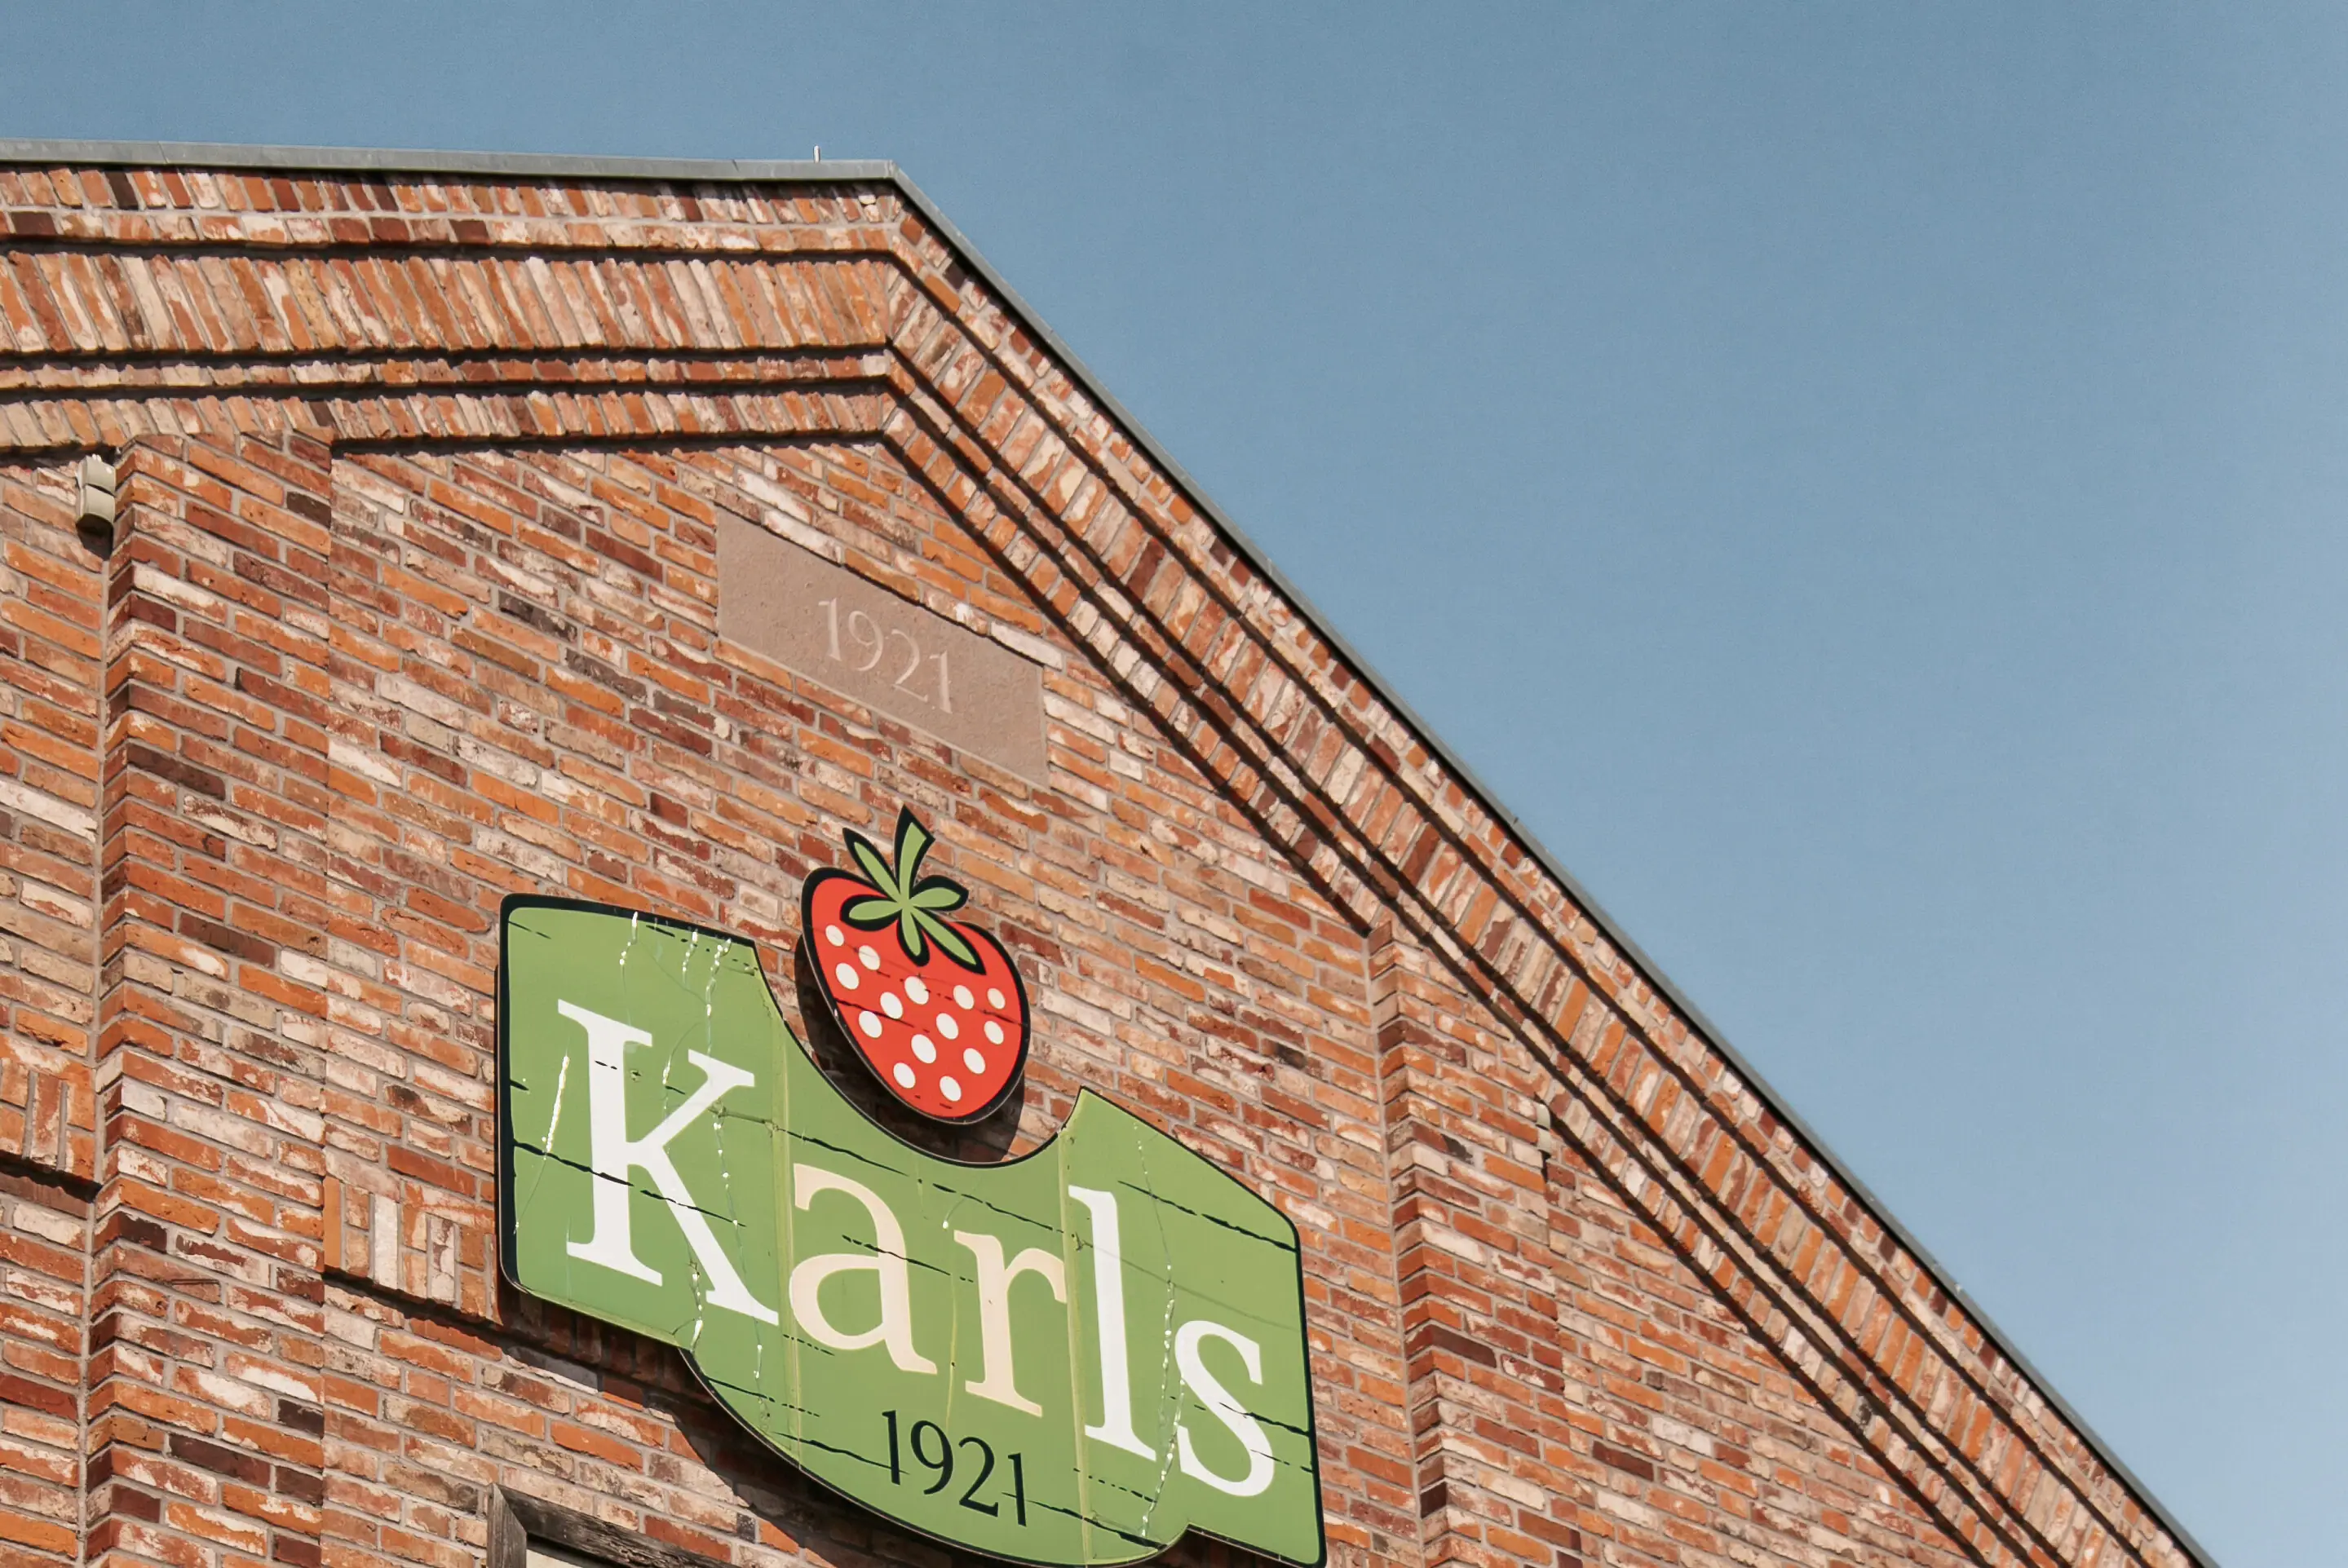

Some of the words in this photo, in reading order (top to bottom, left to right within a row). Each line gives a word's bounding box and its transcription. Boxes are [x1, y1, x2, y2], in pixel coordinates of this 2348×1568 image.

[818, 597, 952, 714] 1921
[558, 999, 1275, 1498] Karls
[882, 1410, 1027, 1527] 1921
